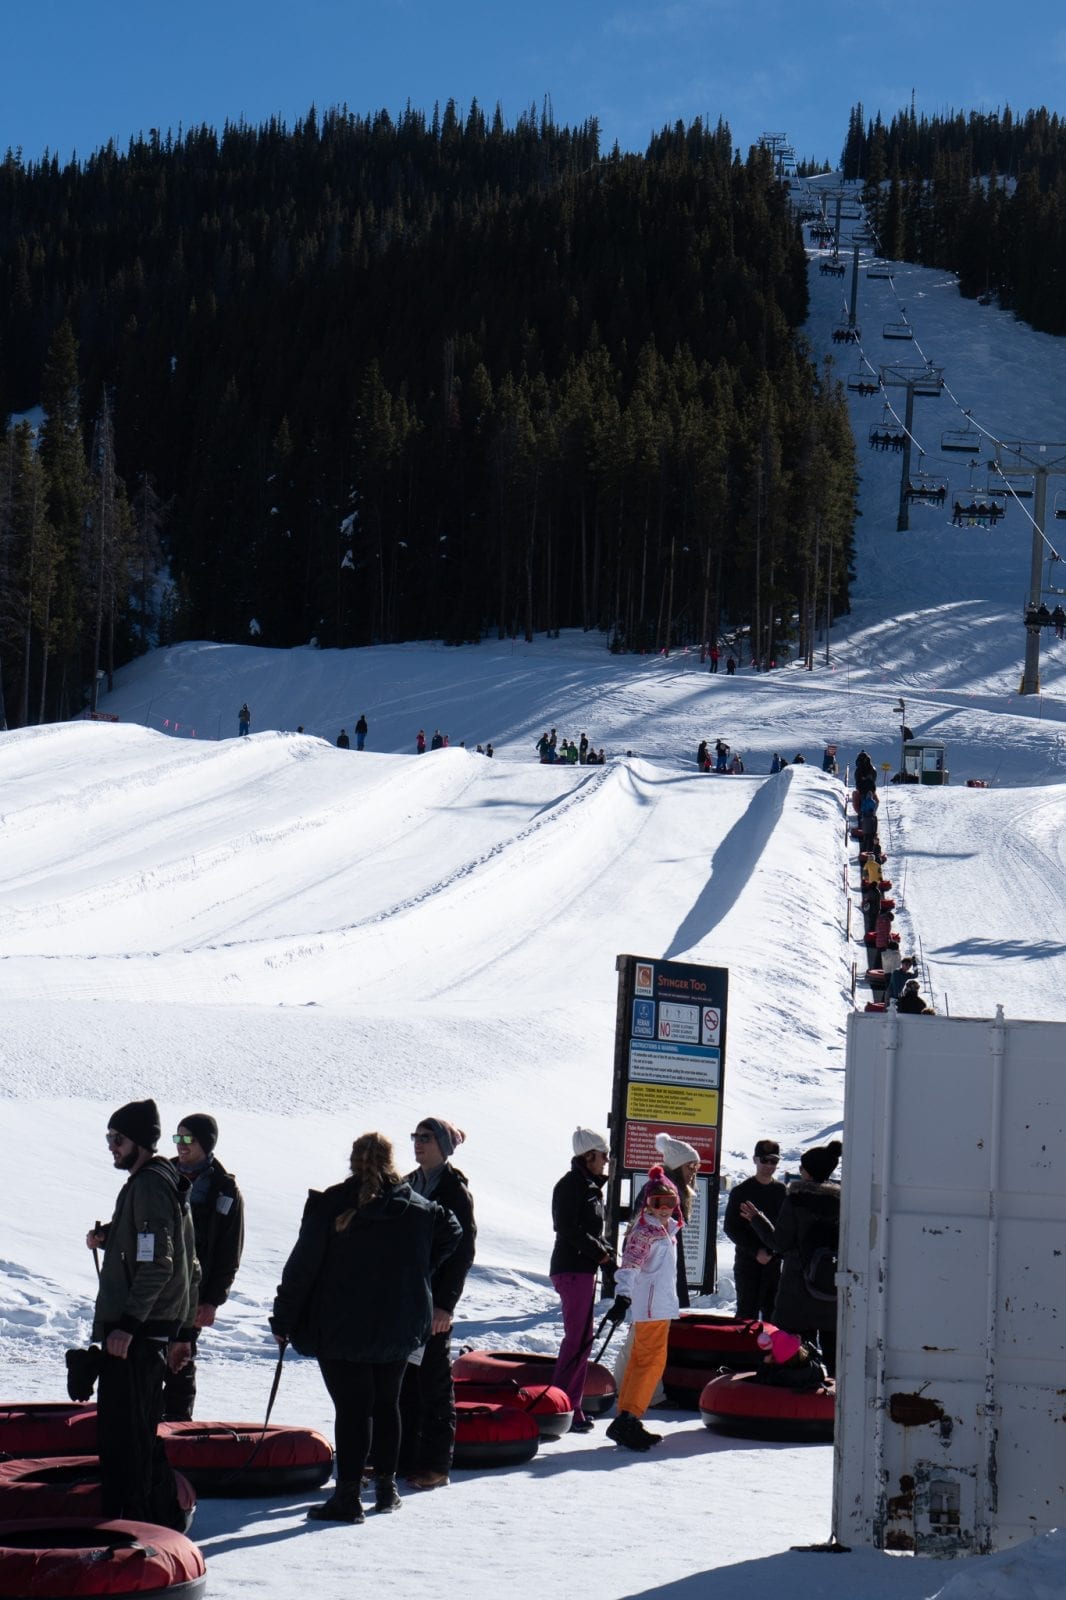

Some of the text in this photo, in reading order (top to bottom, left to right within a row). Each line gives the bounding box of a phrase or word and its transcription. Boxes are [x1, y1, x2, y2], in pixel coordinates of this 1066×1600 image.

[637, 1018, 650, 1027] REMAIN
[634, 1026, 651, 1035] STANDING
[660, 1022, 670, 1037] NO
